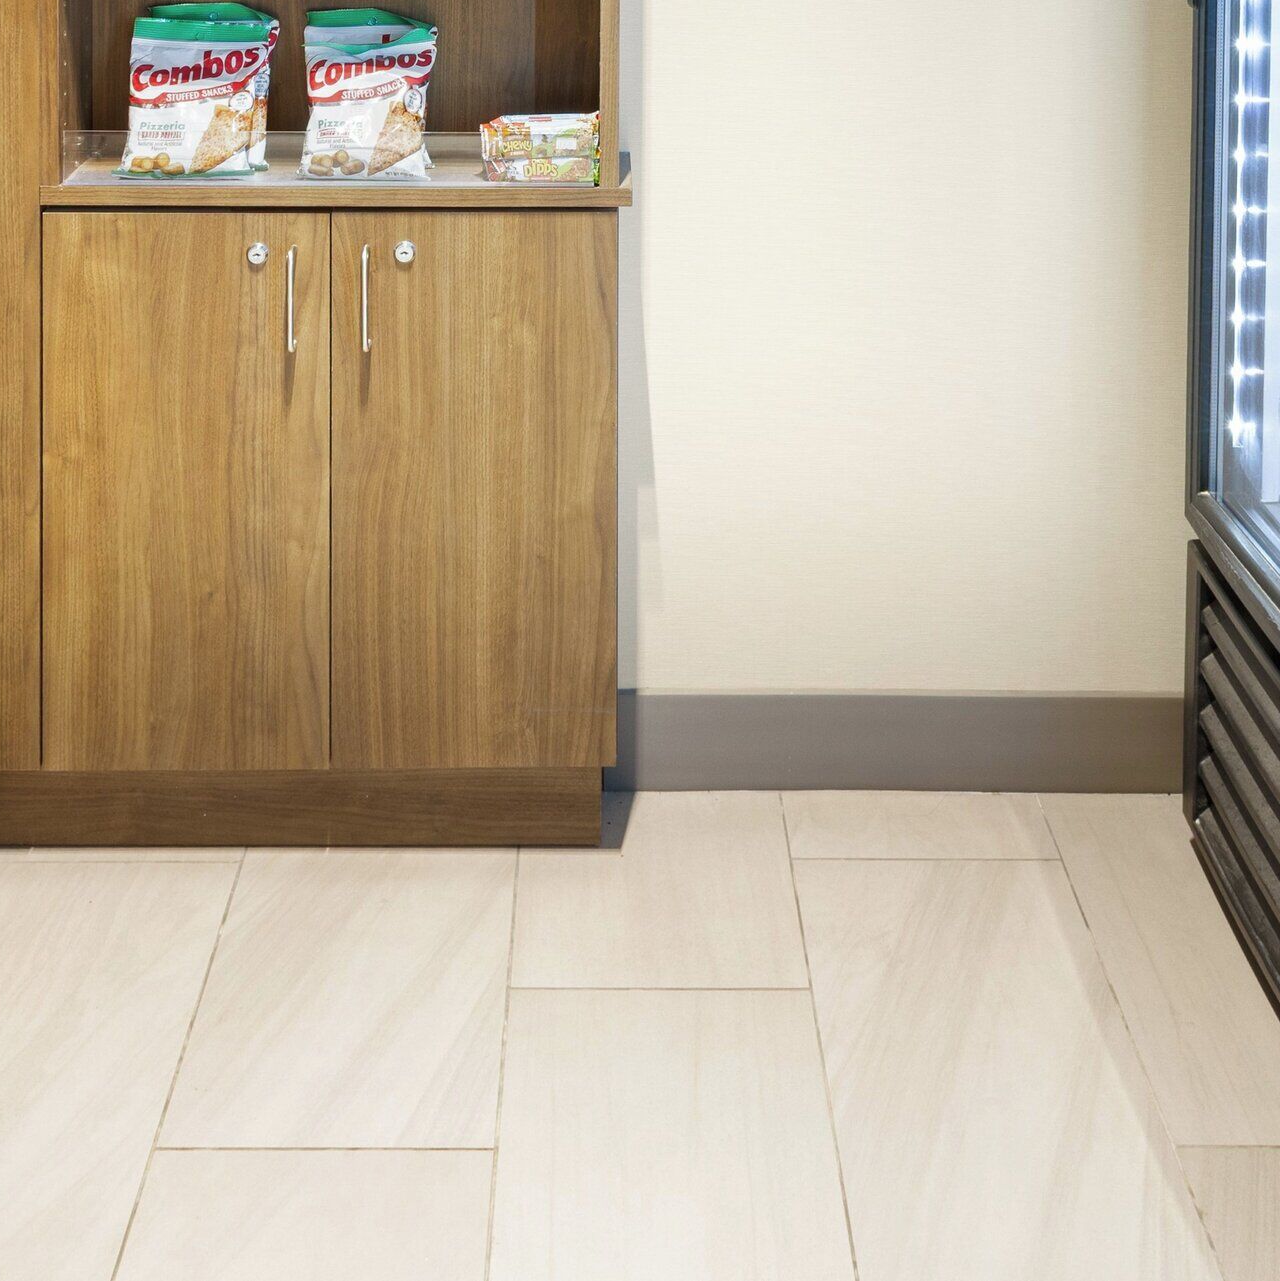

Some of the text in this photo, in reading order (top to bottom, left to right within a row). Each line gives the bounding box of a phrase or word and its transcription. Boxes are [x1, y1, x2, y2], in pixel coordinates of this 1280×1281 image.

[131, 46, 260, 91] Combos
[308, 47, 434, 91] Combos
[166, 84, 234, 103] STUFFED SNACKS
[341, 79, 407, 101] STUFFED SNACKS
[139, 121, 186, 131] Pizzeria
